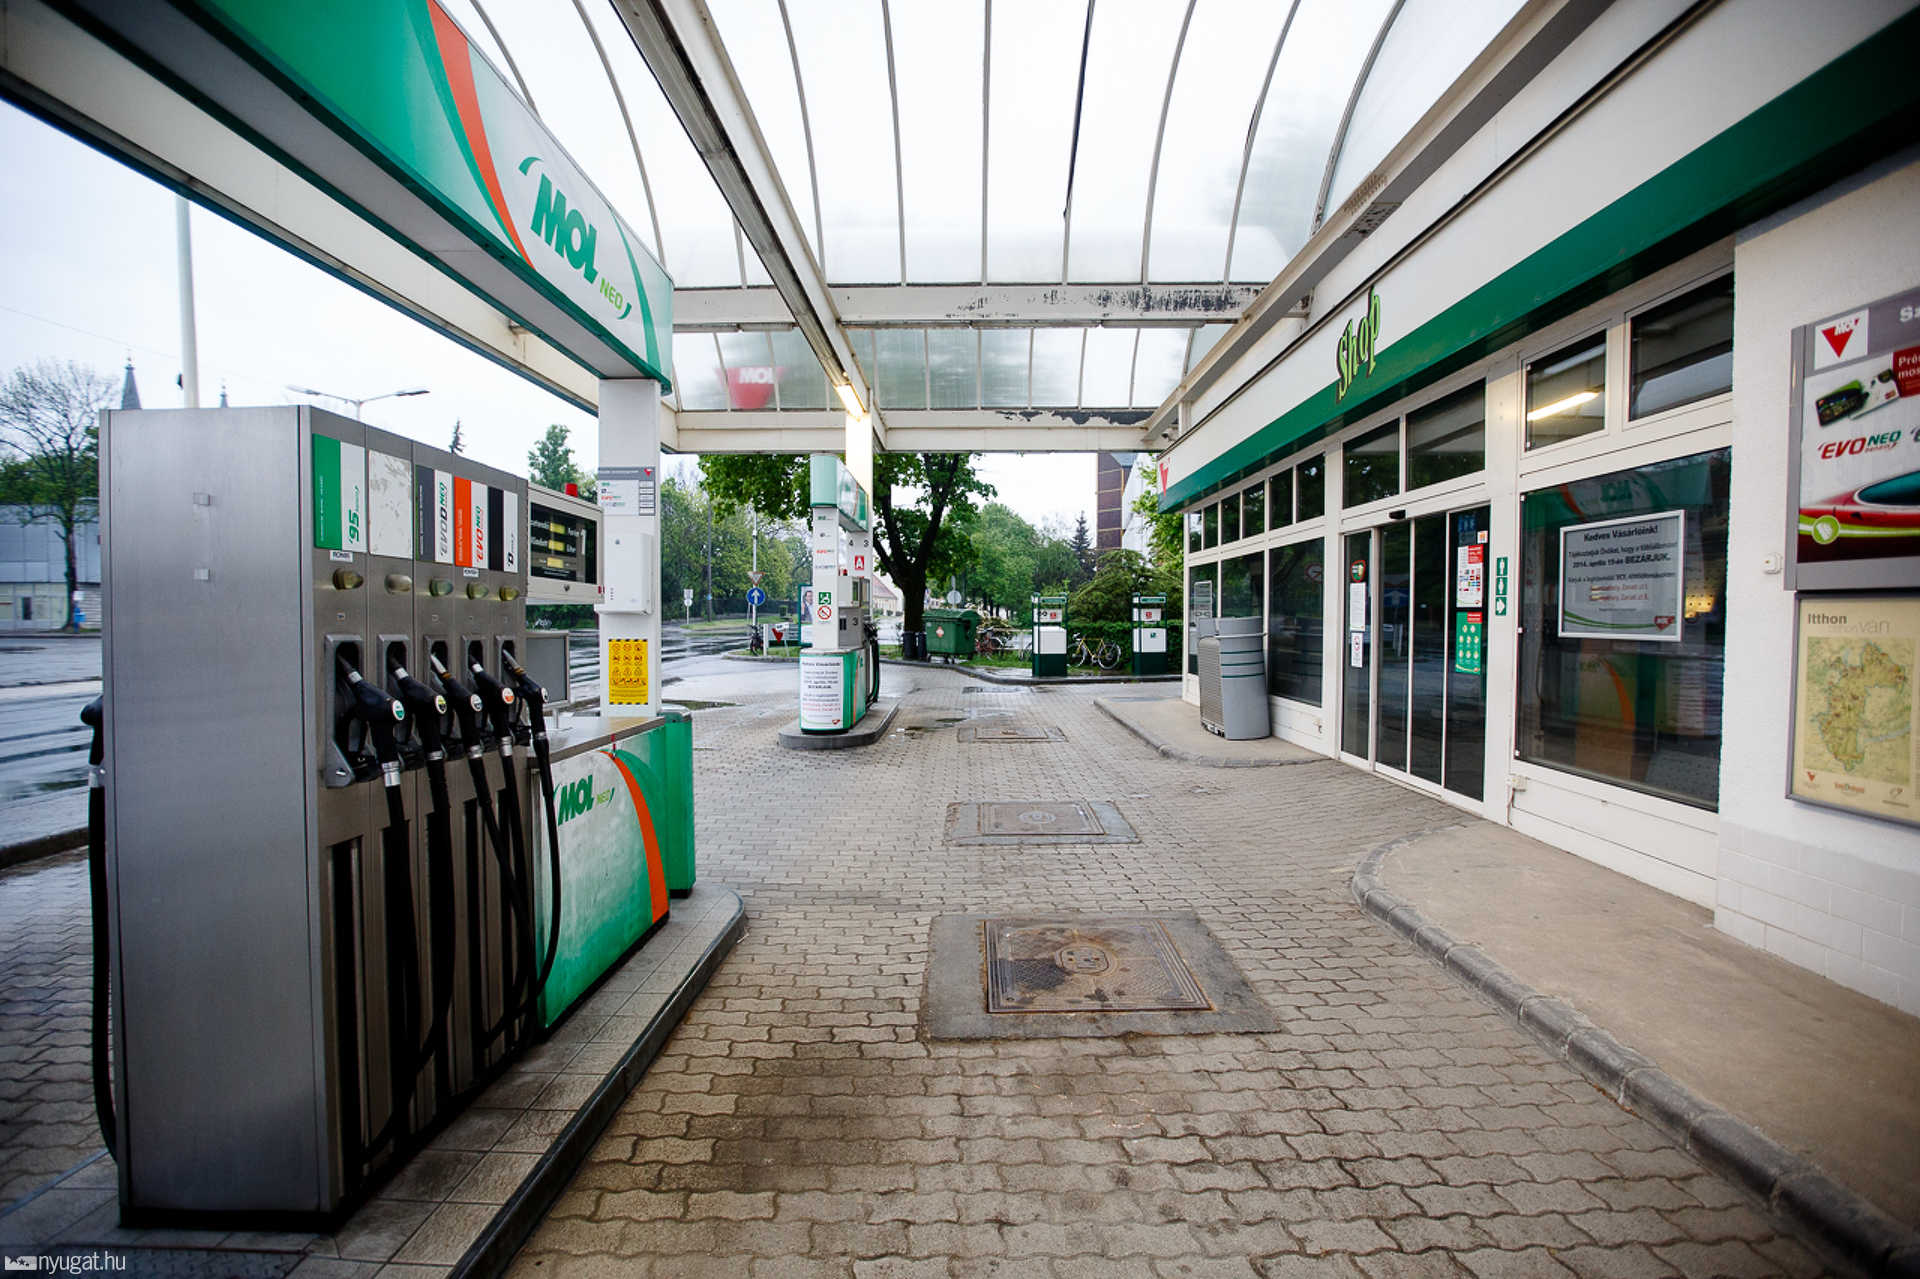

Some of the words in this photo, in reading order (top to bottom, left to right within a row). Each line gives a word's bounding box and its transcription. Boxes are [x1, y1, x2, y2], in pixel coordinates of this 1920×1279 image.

[531, 173, 598, 284] MOL
[600, 277, 623, 310] NEO
[1337, 285, 1380, 403] Shop
[348, 509, 359, 542] 95
[1807, 613, 1847, 625] Itthon
[558, 774, 594, 826] MOL
